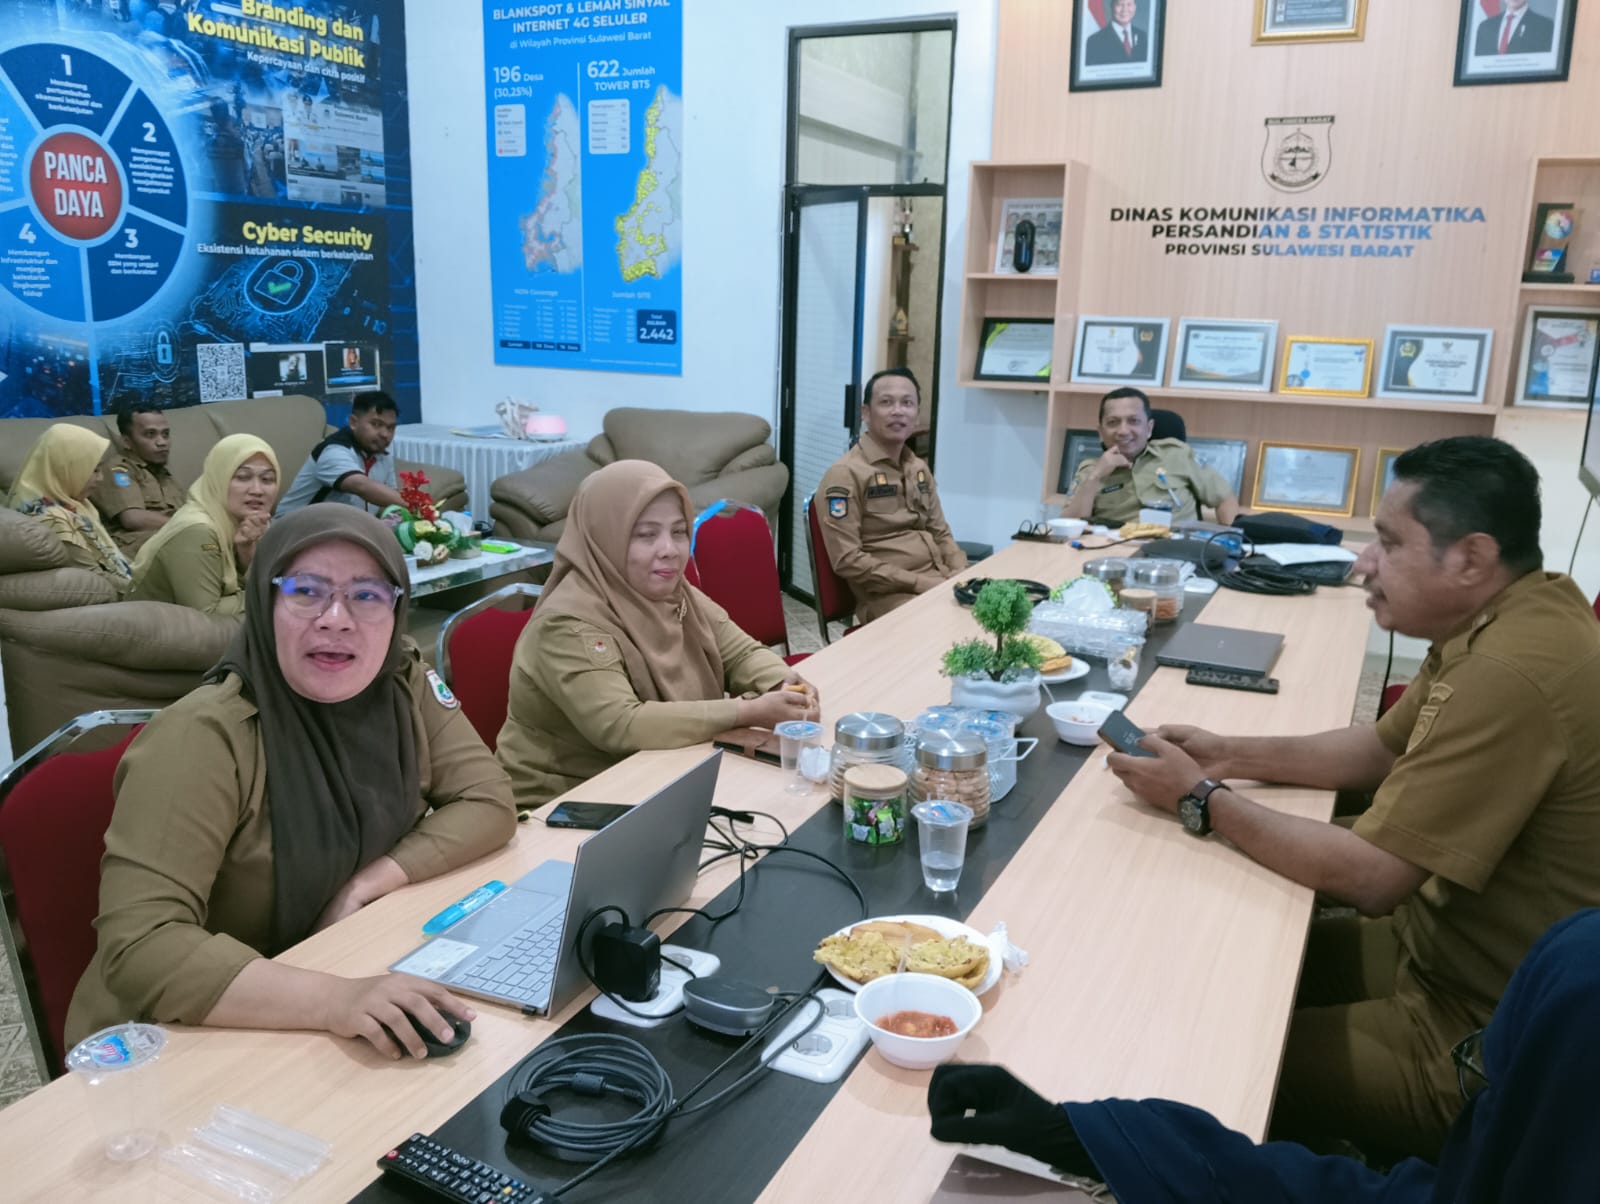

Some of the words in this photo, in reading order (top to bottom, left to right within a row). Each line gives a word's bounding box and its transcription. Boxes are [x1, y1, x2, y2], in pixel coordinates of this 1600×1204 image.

[493, 3, 563, 20] BLANKSPOT
[566, 2, 574, 14] &
[577, 0, 621, 13] LEMAH
[242, 0, 327, 36] Branding
[332, 18, 364, 41] dan
[513, 18, 570, 33] INTERNET
[573, 16, 590, 28] 4G
[593, 12, 648, 27] SELULER
[188, 12, 305, 55] Komunikasi
[310, 40, 366, 68] Publik
[519, 38, 552, 49] Wilayah
[553, 35, 586, 46] Provinsi
[588, 32, 626, 43] Sulawesi
[628, 31, 651, 41] Barat
[61, 53, 72, 76] 1
[247, 51, 303, 71] Kepercayaan
[304, 64, 320, 74] dan
[341, 71, 366, 83] positif
[493, 66, 521, 83] 196
[523, 74, 544, 82] Desa
[587, 60, 620, 78] 622
[622, 66, 656, 76] Jumlah
[594, 81, 630, 91] TOWER
[632, 79, 650, 90] BTS
[142, 122, 157, 143] 2
[44, 151, 108, 184] PANCA
[54, 188, 105, 218] DAYA
[1110, 208, 1173, 222] DINAS
[1180, 207, 1316, 222] KOMUNIKASI
[1324, 207, 1487, 222] INFORMATIKA
[18, 223, 37, 244] 4
[124, 228, 139, 248] 3
[242, 221, 299, 245] Cyber
[302, 225, 373, 250] Security
[1152, 224, 1290, 239] PERSANDIAN
[1297, 224, 1311, 239] &
[1318, 224, 1433, 240] STATISTIK
[197, 243, 244, 255] Eksistensi
[245, 245, 291, 257] ketahanan
[292, 248, 320, 259] sistem
[320, 249, 374, 261] berkelanjutan
[1165, 243, 1246, 256] PROVINSI
[1251, 243, 1344, 257] SULAWESI
[1350, 244, 1415, 258] BARAT
[639, 327, 675, 341] 2.442
